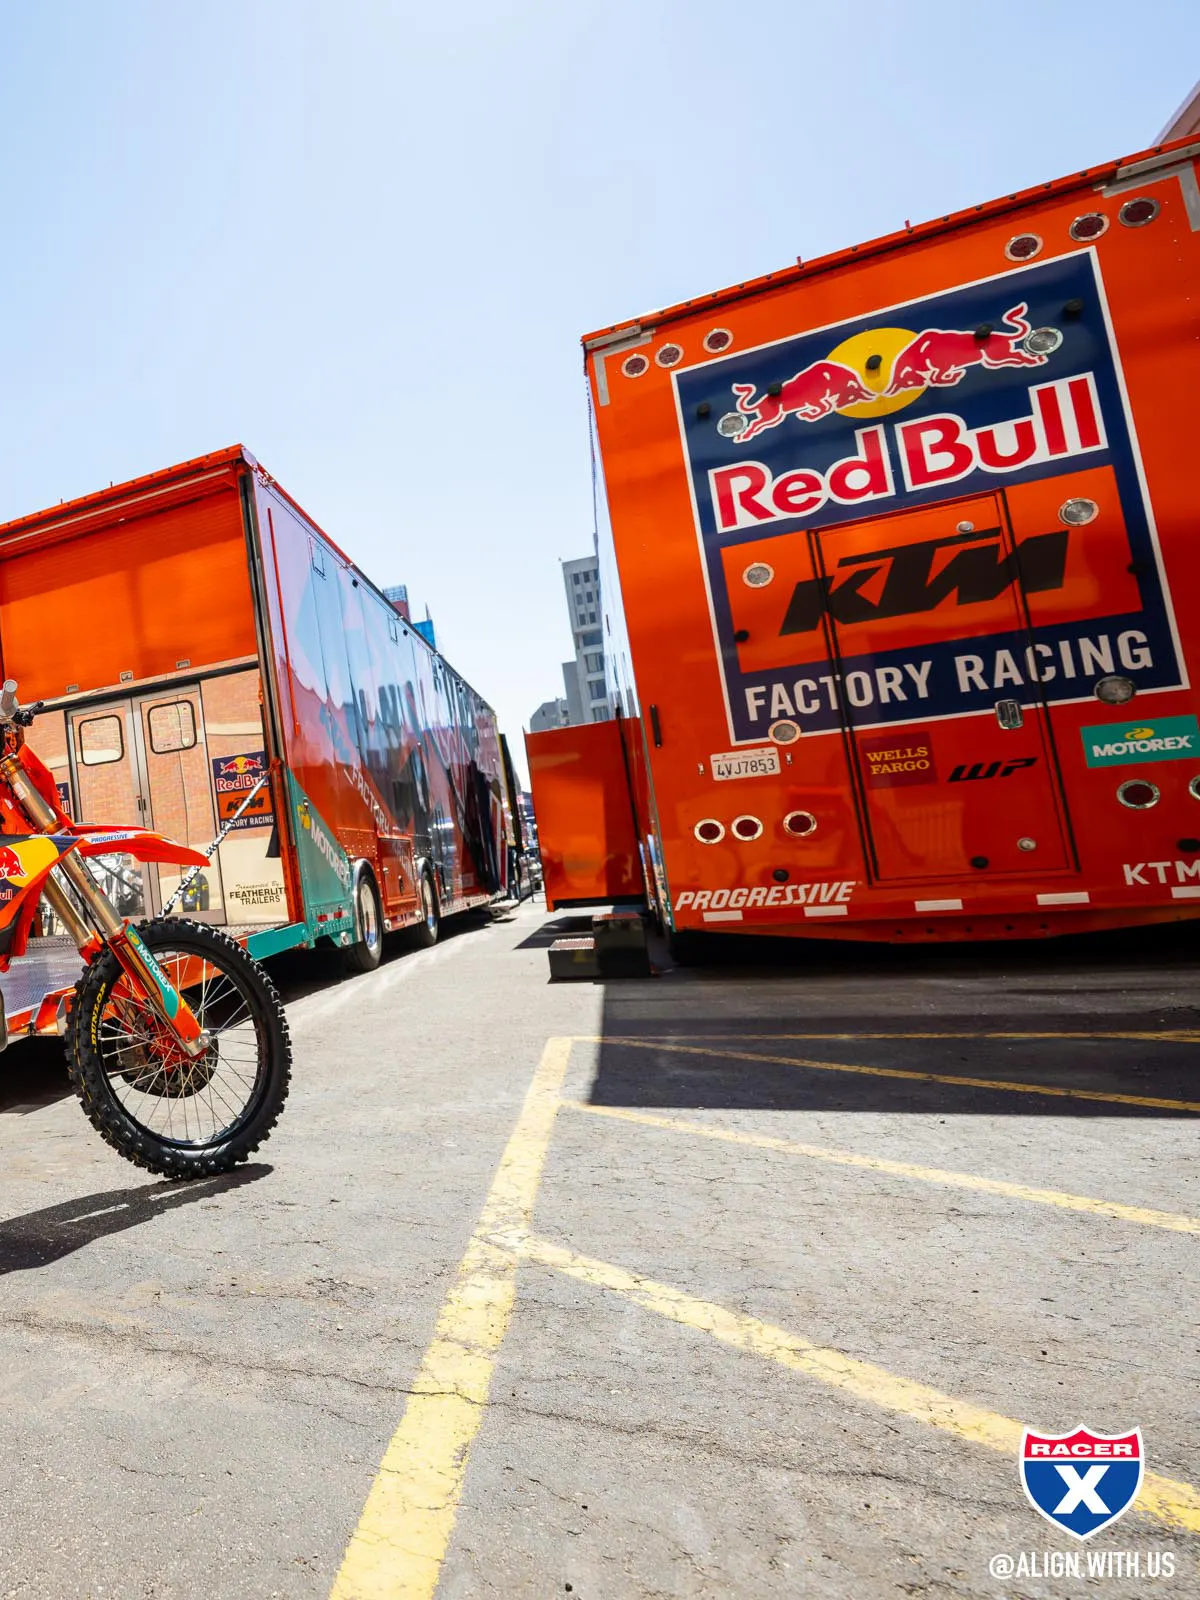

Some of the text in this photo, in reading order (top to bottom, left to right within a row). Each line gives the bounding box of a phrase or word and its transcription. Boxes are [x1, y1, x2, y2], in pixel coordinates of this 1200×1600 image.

[708, 371, 1109, 533] Red Bull
[779, 526, 1069, 636] KTM
[744, 629, 1153, 721] FACTORY RACING
[866, 746, 929, 763] WELLS
[1092, 735, 1193, 757] MOTOREX
[717, 758, 776, 776] 4VJ7853
[870, 759, 930, 775] FARGO
[216, 774, 243, 792] Red
[249, 815, 274, 825] RACING
[229, 886, 287, 900] FEATHERLIT
[240, 894, 281, 906] TRAILERS
[674, 881, 857, 911] PROGRESSIVE
[136, 943, 173, 992] MOTOREX
[91, 982, 107, 1046] DUNLOP
